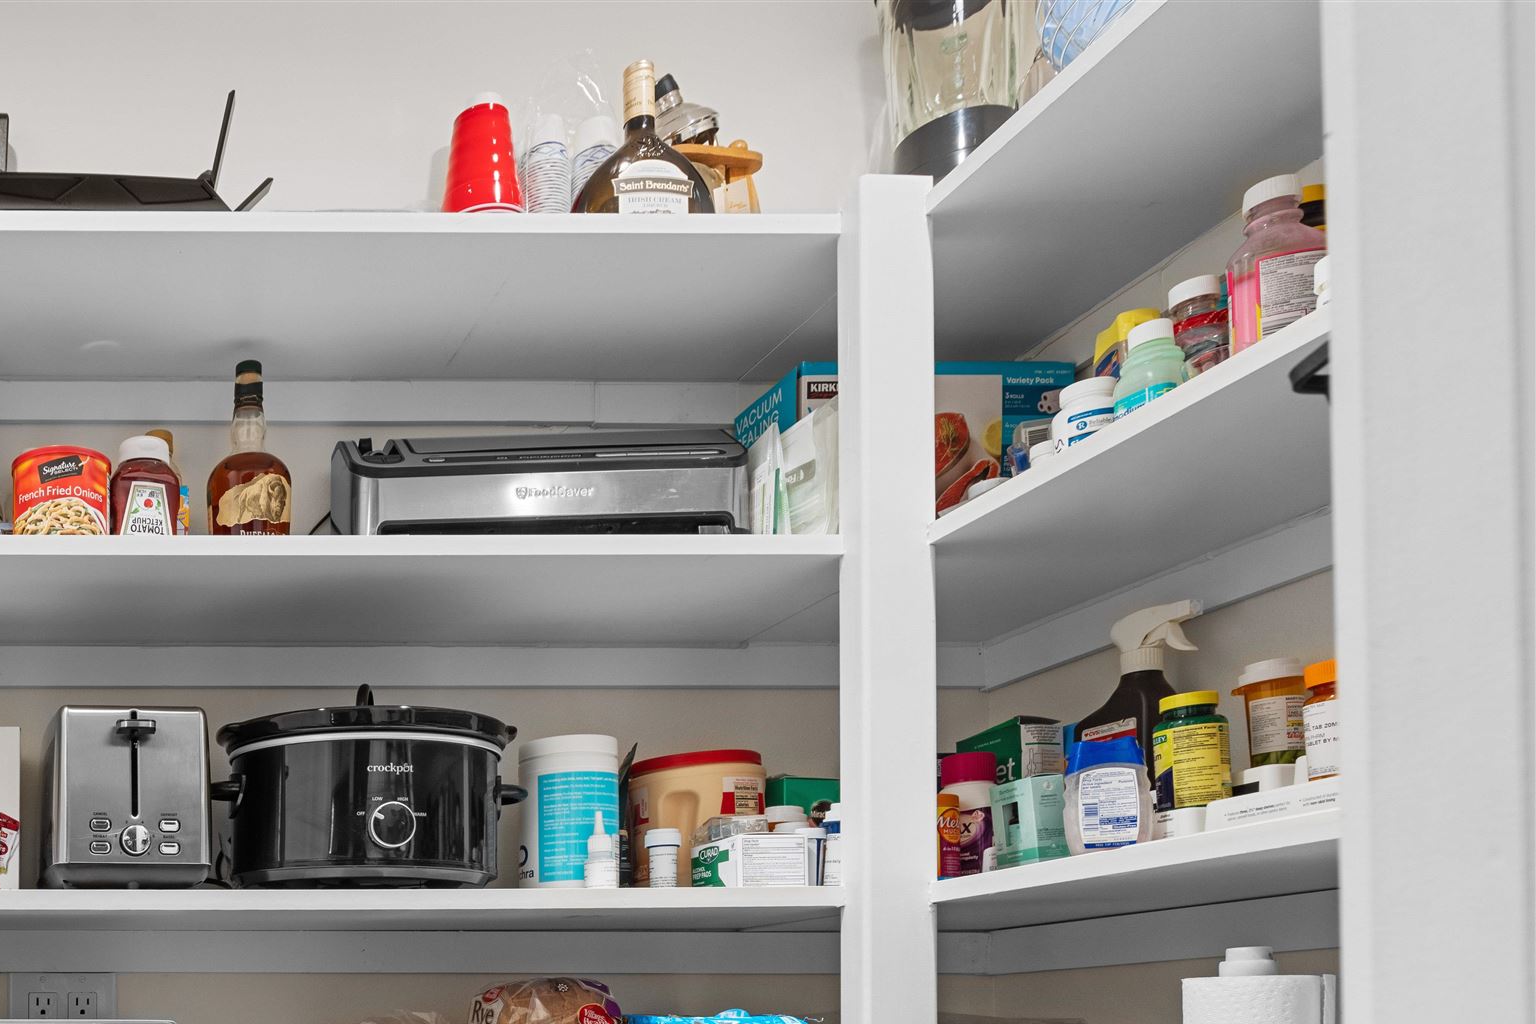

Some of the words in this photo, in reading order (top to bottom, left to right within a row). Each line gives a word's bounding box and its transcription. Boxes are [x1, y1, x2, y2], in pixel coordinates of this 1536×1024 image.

[619, 179, 643, 191] Saint
[645, 180, 690, 194] Brendan's
[1006, 375, 1036, 386] Variety
[1037, 375, 1054, 385] Pack
[1005, 391, 1010, 399] 3
[735, 388, 784, 435] VACUUM
[43, 460, 77, 475] Signature
[18, 488, 45, 504] French
[46, 485, 71, 497] Fried
[73, 486, 103, 503] Onions
[527, 487, 594, 499] FoodSaver
[132, 517, 163, 526] KETCHUP
[130, 524, 165, 535] TOMATO
[366, 762, 414, 775] crockpot
[699, 847, 719, 859] CURAD
[693, 872, 701, 880] PREP
[583, 1008, 605, 1022] Village
